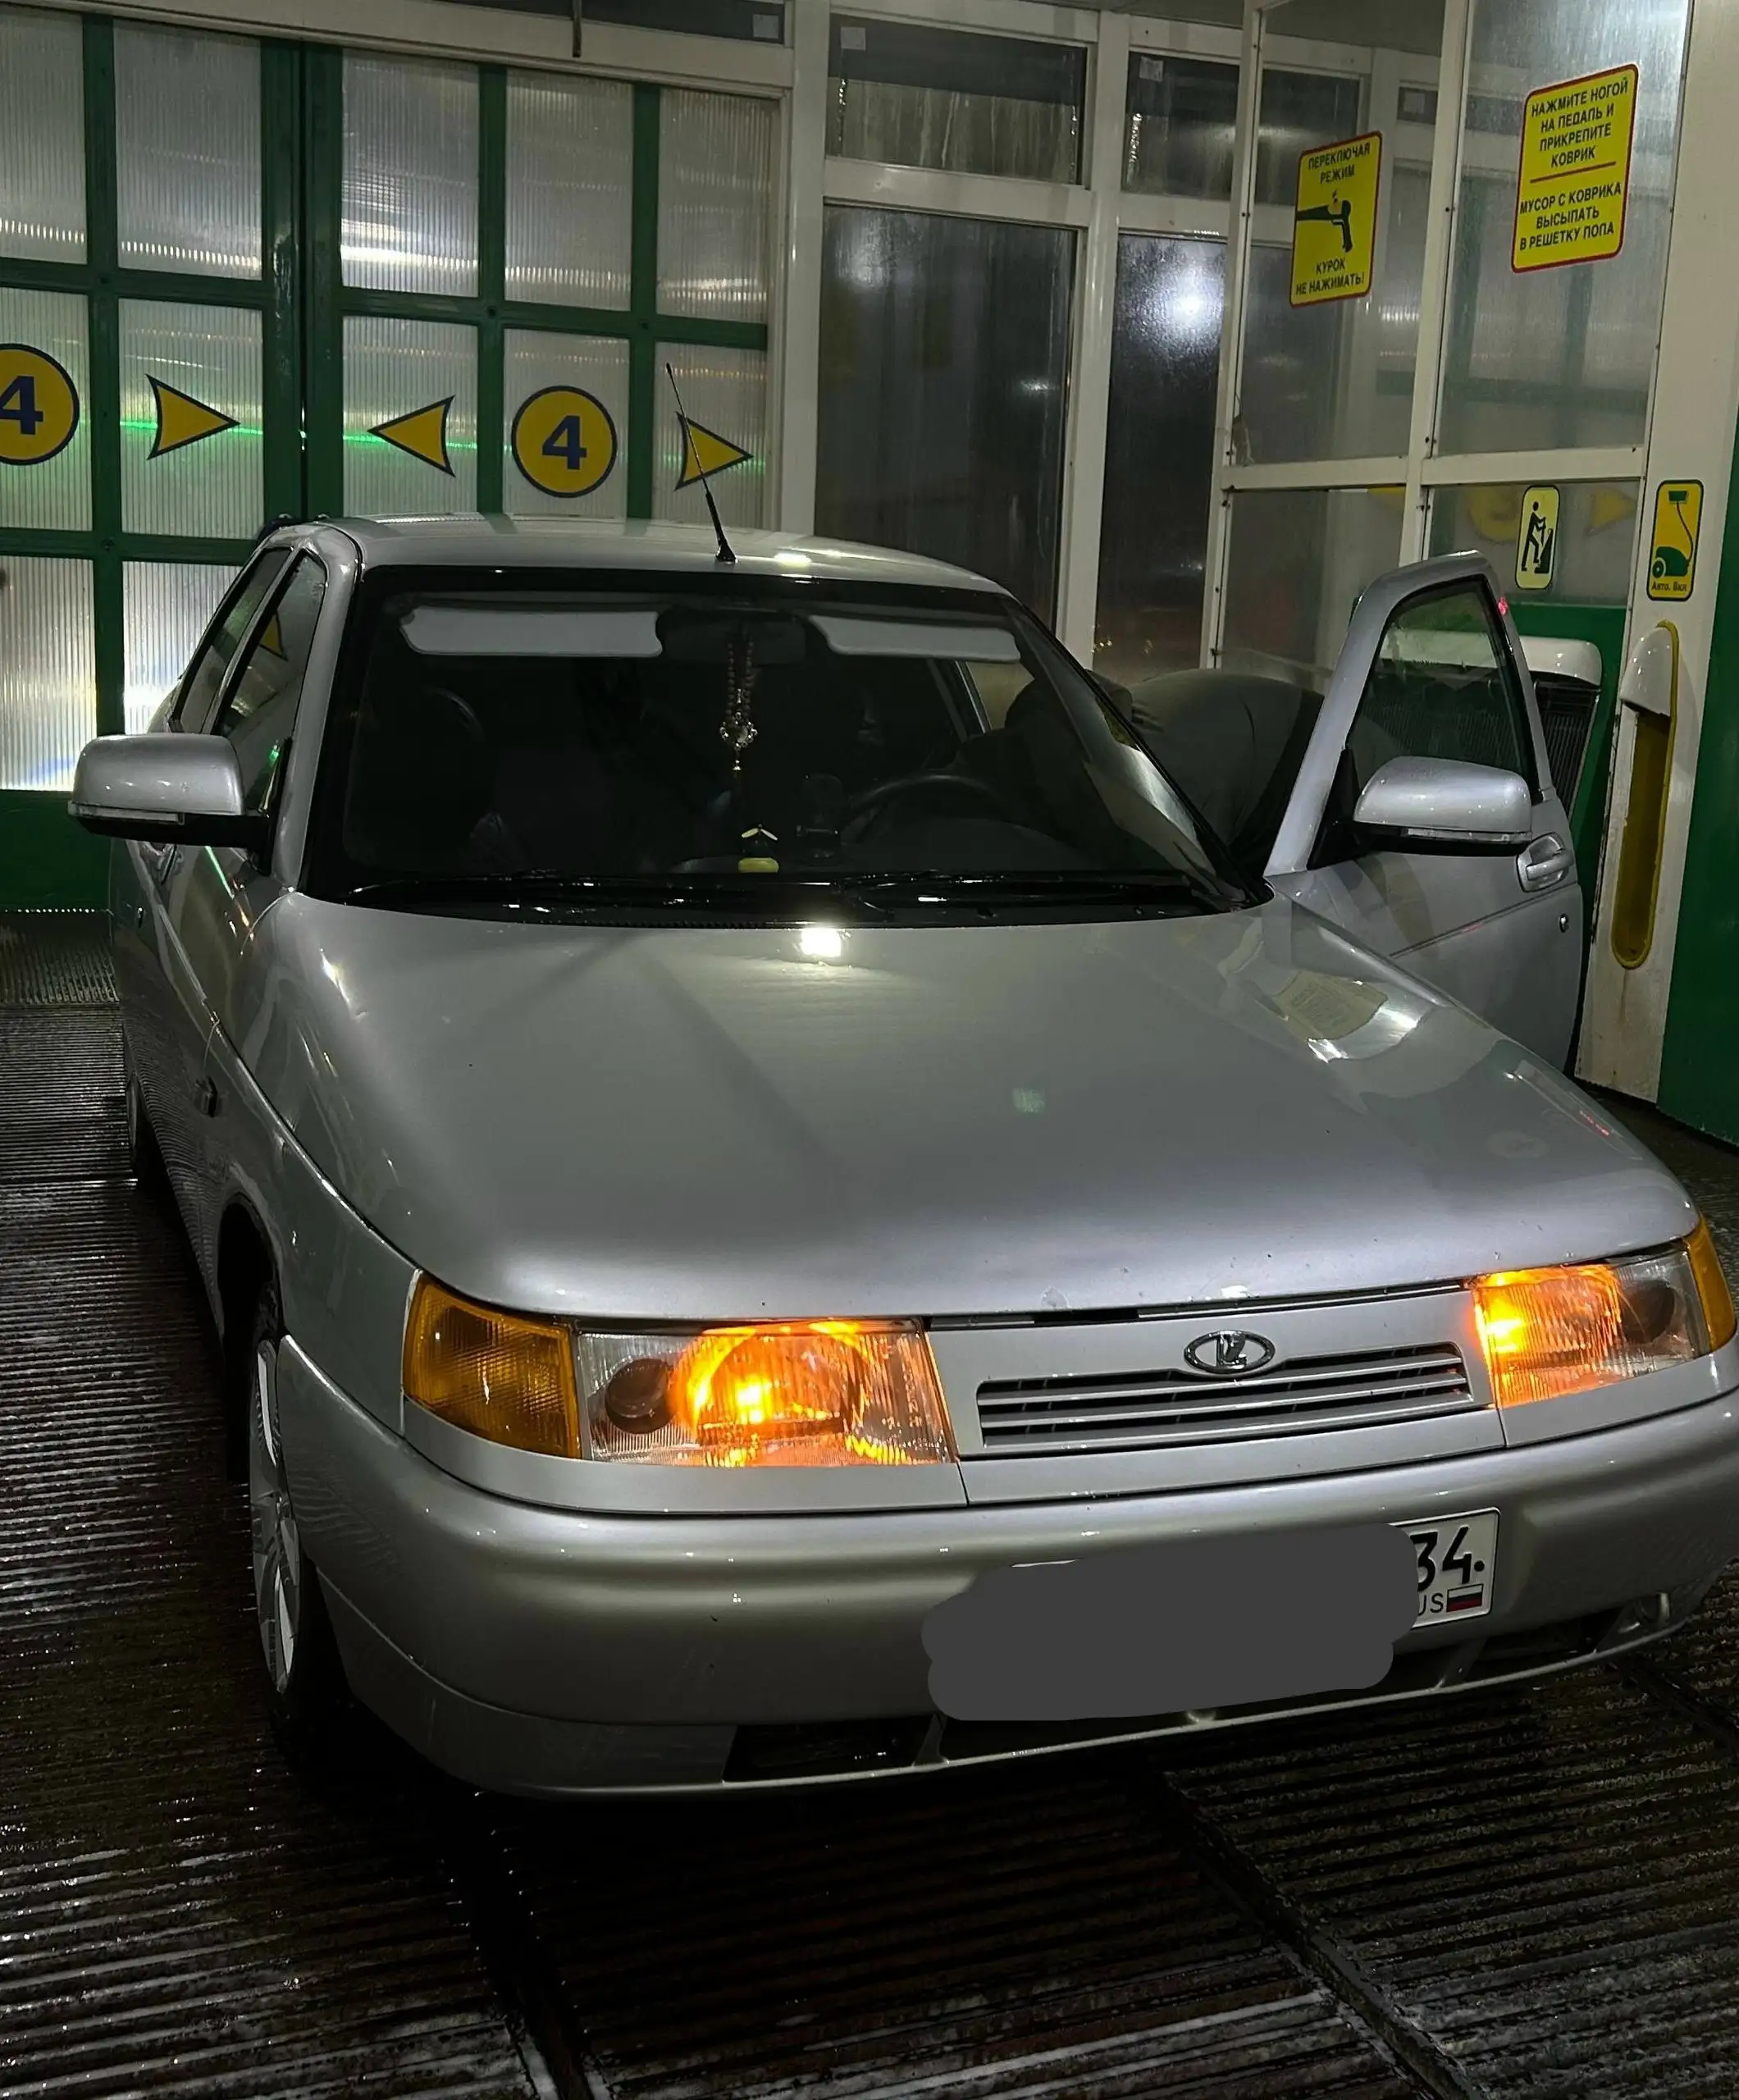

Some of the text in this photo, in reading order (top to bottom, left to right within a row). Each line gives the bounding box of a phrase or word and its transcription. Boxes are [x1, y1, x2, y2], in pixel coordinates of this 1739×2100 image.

[1531, 76, 1628, 117] НАЖМИТЕ НОГОЙ
[1540, 117, 1555, 134] НА
[1606, 103, 1614, 117] И
[1540, 123, 1611, 151] ПРИКРЕПИТЕ
[1551, 145, 1596, 168] КОВРИК
[1320, 164, 1355, 185] РЕЖИМ
[1519, 181, 1622, 215] МУСОР С КОВРИКА
[1536, 205, 1600, 230] ВЫСЫПАТЬ
[1519, 236, 1527, 251] В
[1529, 226, 1581, 249] РЕШЕТКУ
[1316, 258, 1346, 276] КУРОК
[1296, 272, 1365, 295] НЕ НАЖИМАТЬ!
[0, 375, 43, 436] 4
[541, 414, 588, 470] 4
